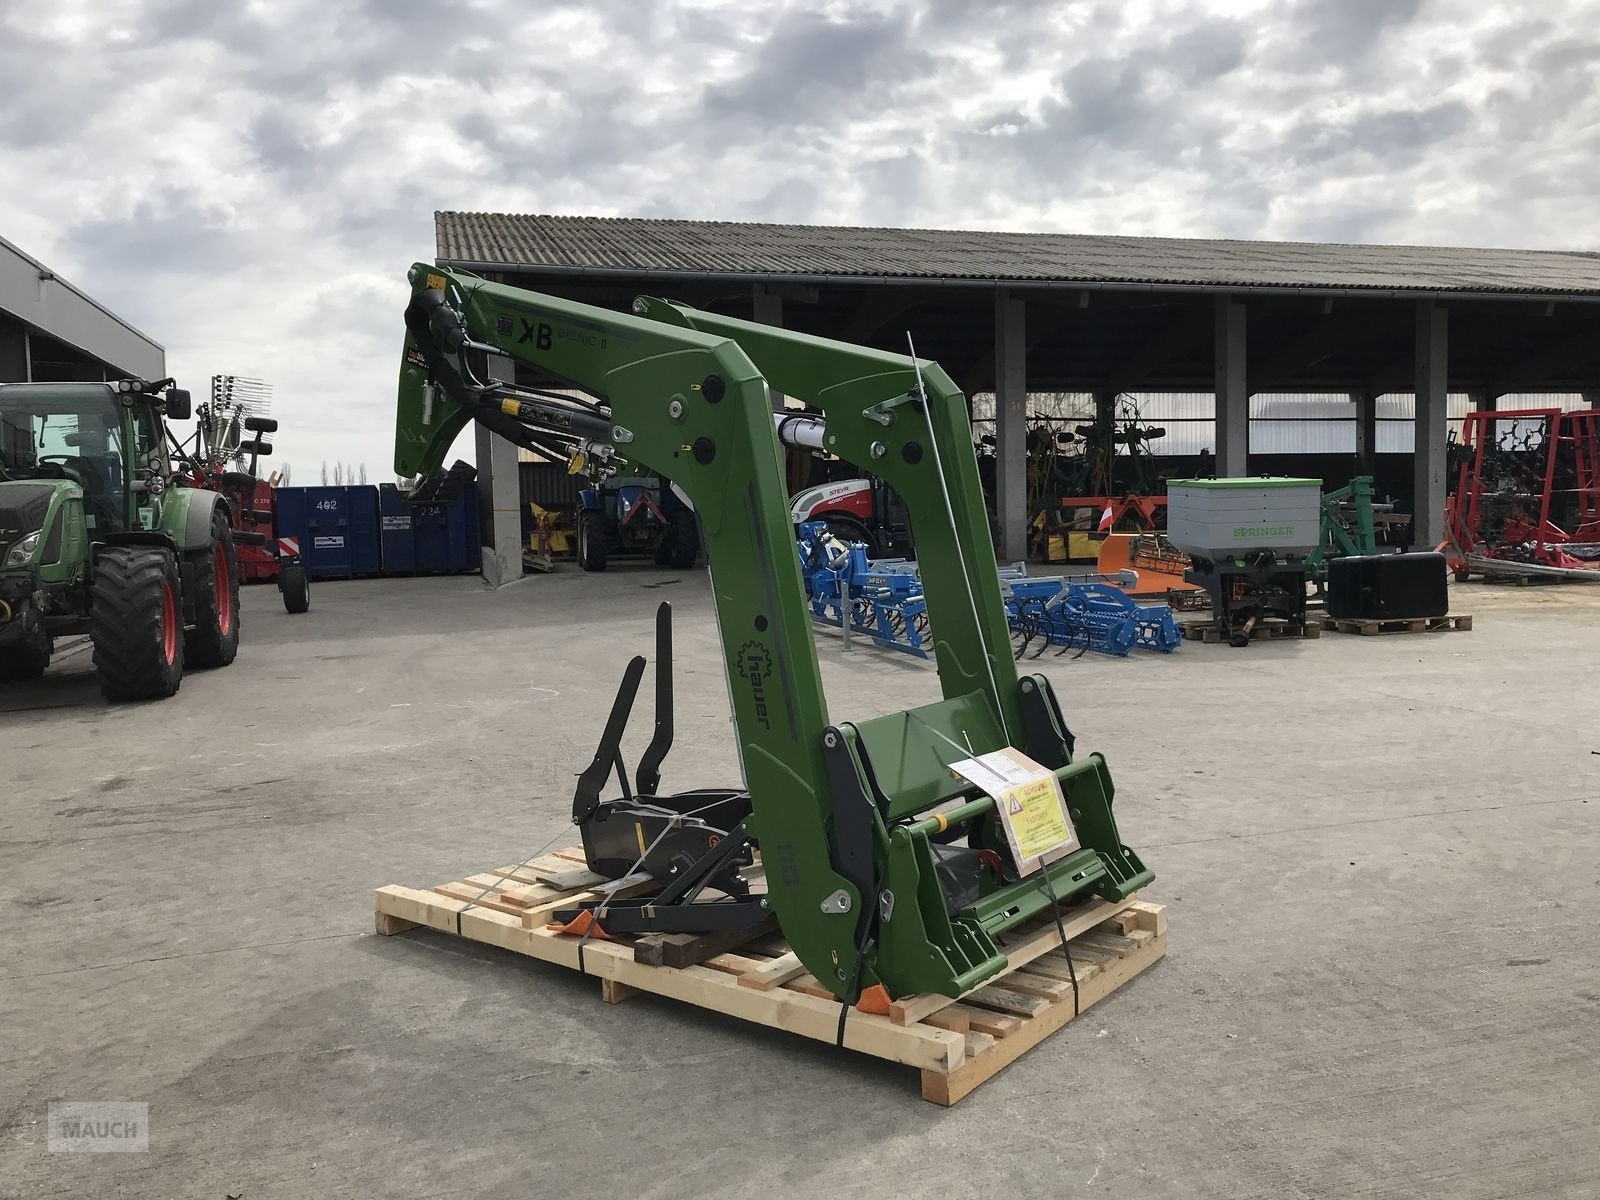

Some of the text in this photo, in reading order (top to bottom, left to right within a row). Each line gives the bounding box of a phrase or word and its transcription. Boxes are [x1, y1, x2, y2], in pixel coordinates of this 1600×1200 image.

[830, 487, 849, 496] STEYR
[1233, 527, 1293, 537] SPRINGER
[747, 655, 770, 730] hauer
